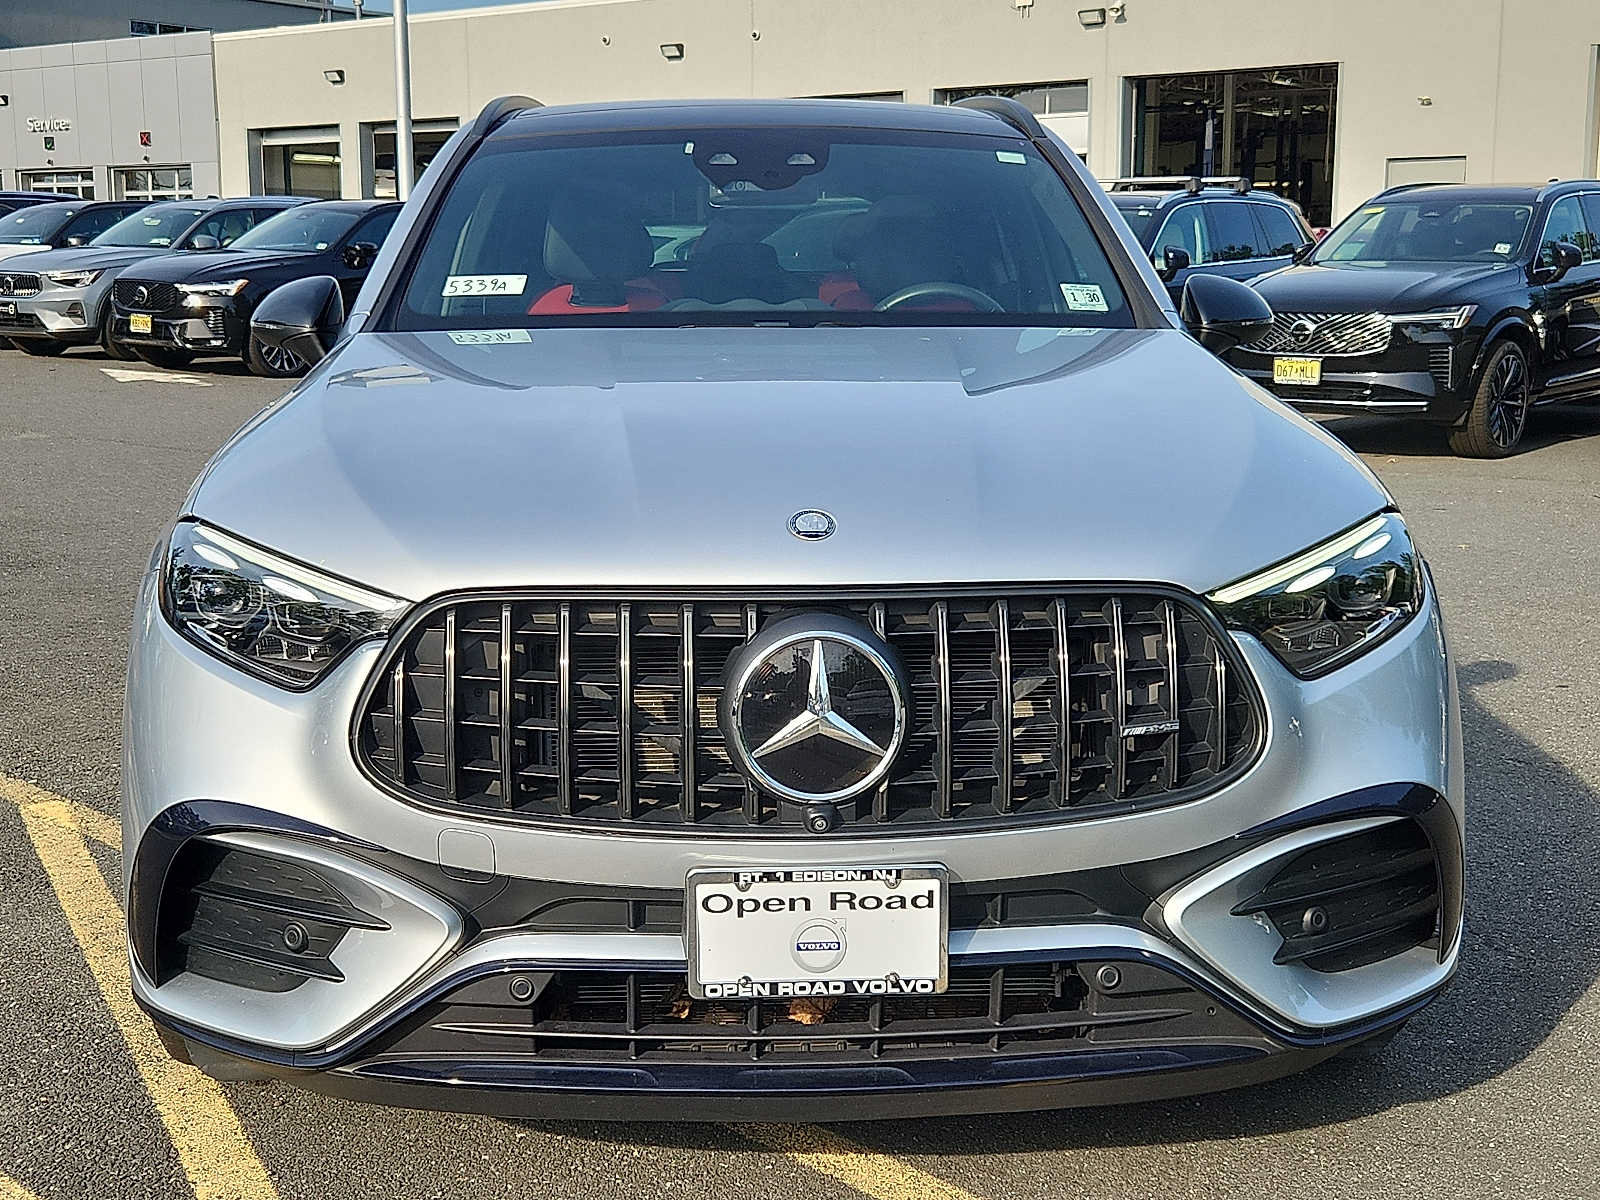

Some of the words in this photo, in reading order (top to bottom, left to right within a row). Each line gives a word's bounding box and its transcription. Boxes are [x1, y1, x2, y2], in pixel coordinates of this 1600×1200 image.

[448, 278, 507, 294] 5339A
[1085, 292, 1100, 303] 30
[739, 871, 767, 883] RT.
[776, 871, 784, 882] 1
[792, 870, 866, 882] EDISON,
[873, 869, 897, 881] NJ
[702, 894, 811, 918] Open
[830, 890, 934, 911] Road
[798, 942, 839, 950] VOLVO
[705, 983, 770, 997] OPEN
[778, 981, 845, 996] ROAD
[852, 980, 933, 995] VOLVO
